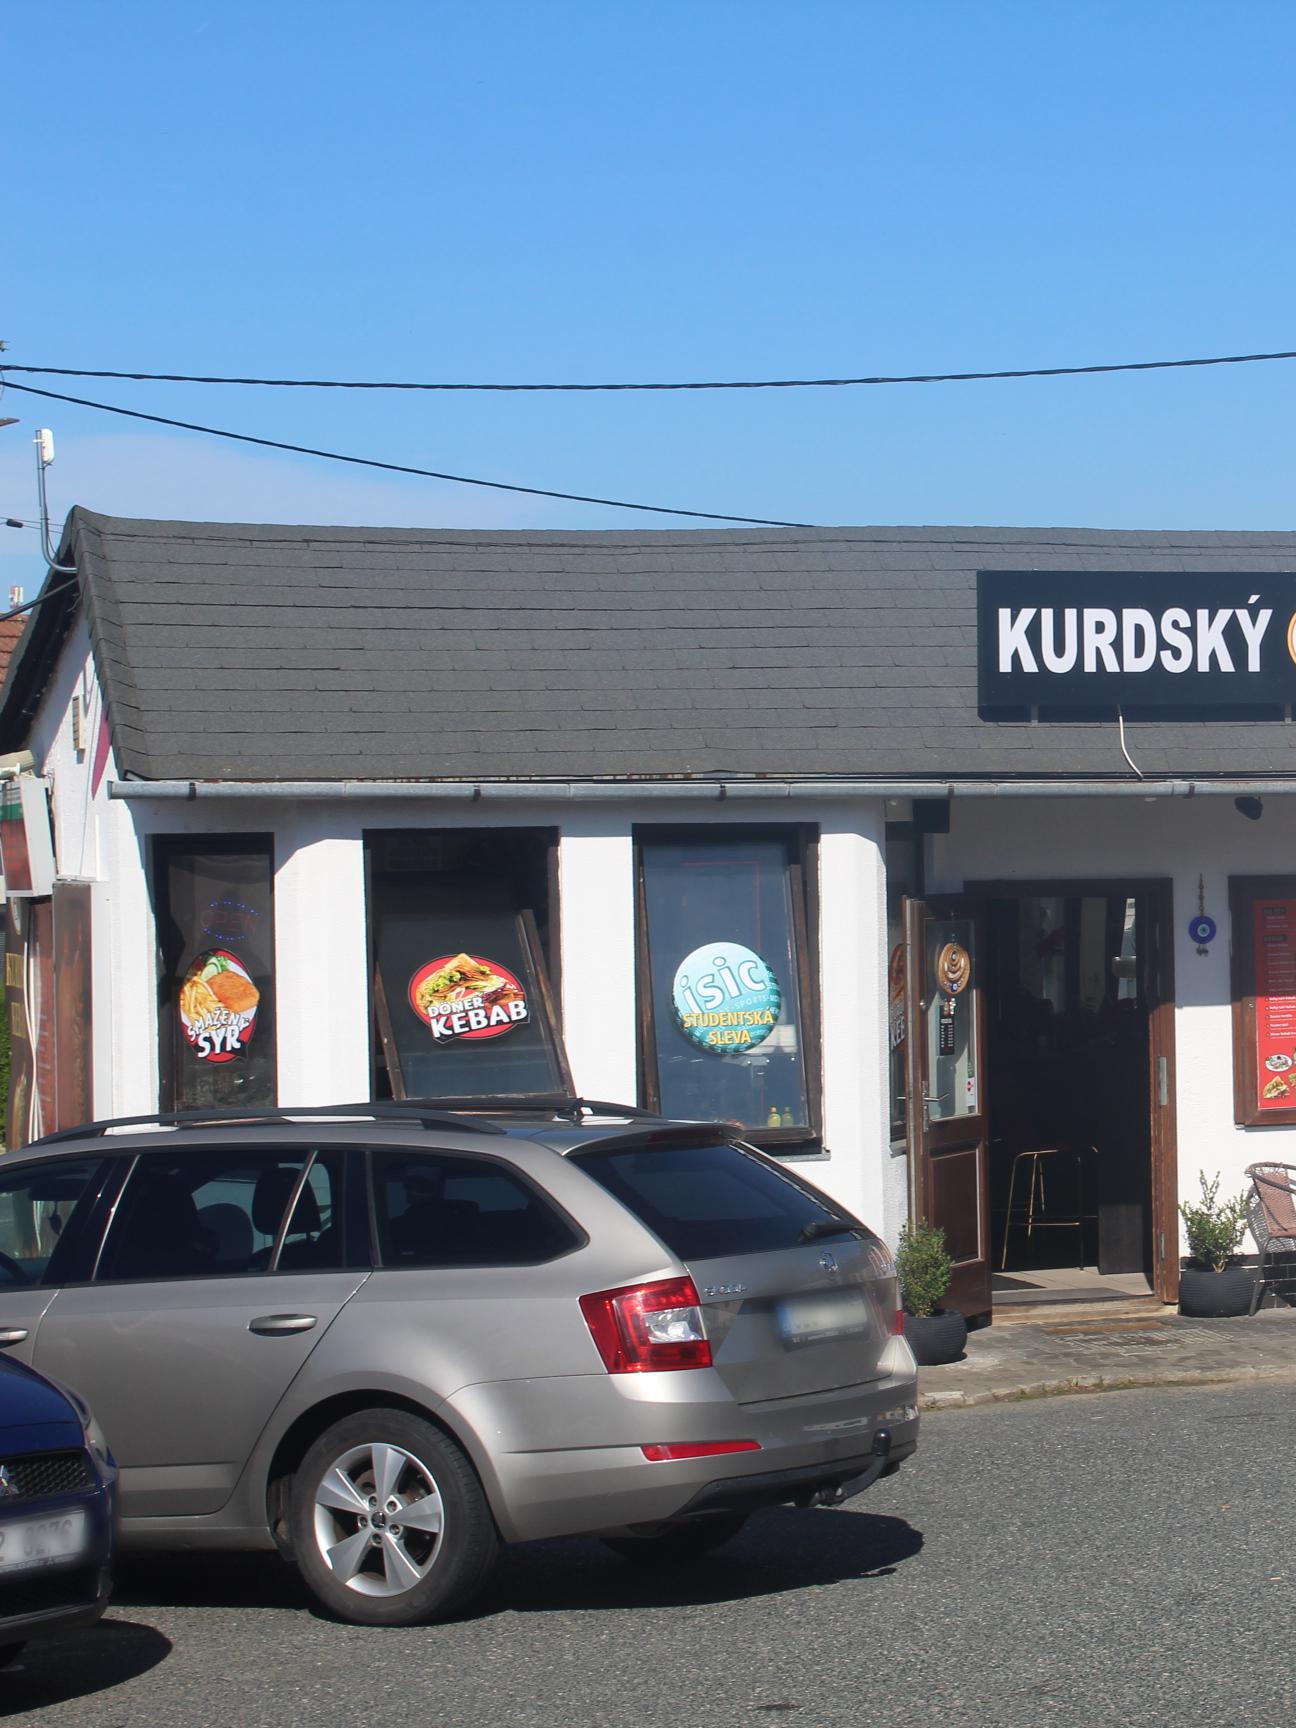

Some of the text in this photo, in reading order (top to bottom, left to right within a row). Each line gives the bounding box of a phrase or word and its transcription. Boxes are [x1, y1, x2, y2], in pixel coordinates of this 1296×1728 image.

[997, 594, 1273, 674] KURDSKÝ
[427, 997, 485, 1017] DÖNER
[683, 1006, 774, 1028] STUDENTSKÁ
[430, 1001, 528, 1038] KEBAB
[707, 1029, 752, 1045] SLEVA
